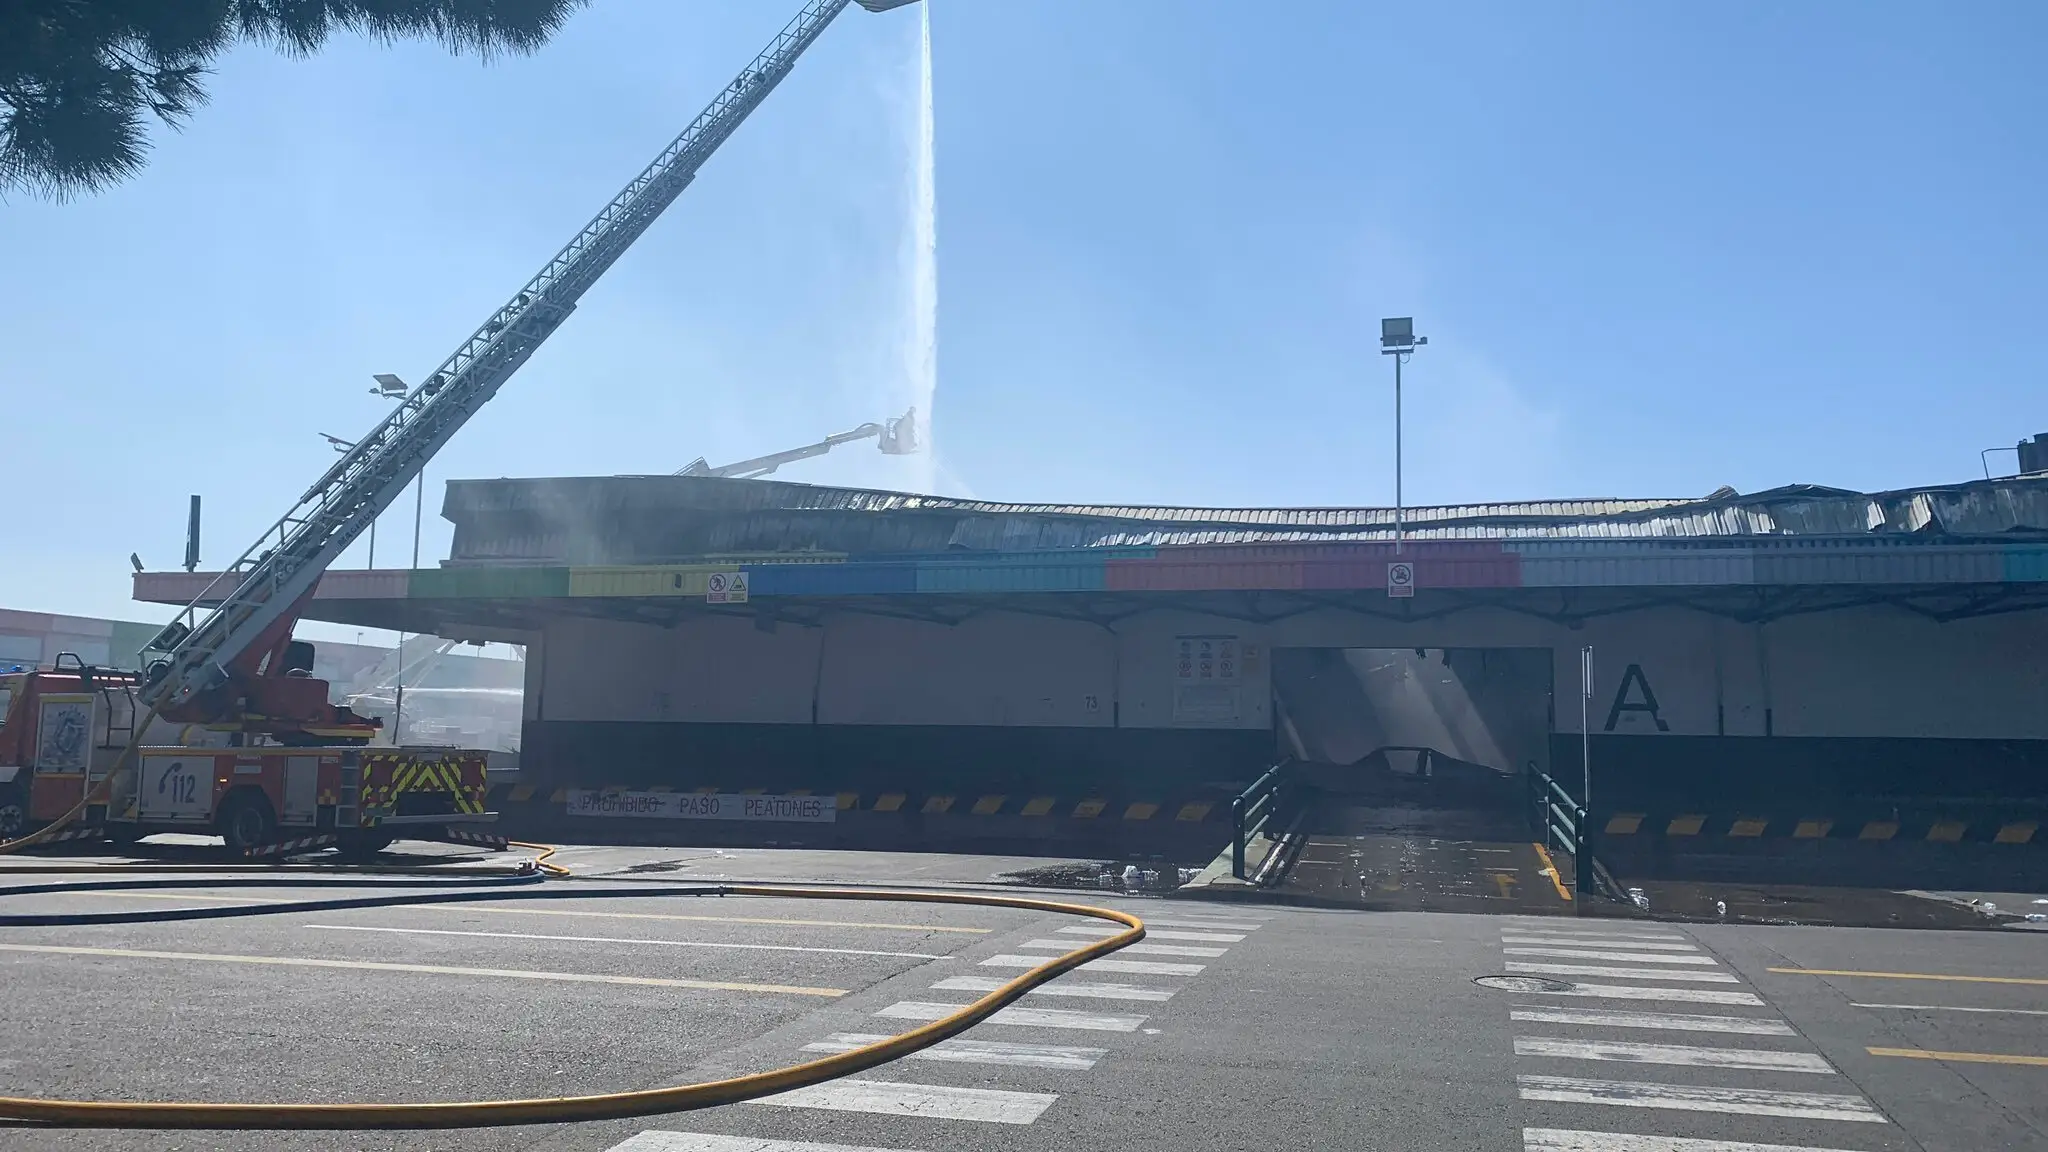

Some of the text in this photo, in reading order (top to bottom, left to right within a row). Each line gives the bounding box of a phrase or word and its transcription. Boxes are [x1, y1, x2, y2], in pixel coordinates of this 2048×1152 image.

[1085, 695, 1098, 710] 73
[1604, 664, 1670, 731] A
[172, 774, 196, 804] 112
[680, 797, 720, 815] PASO
[744, 798, 821, 818] PEATONES
